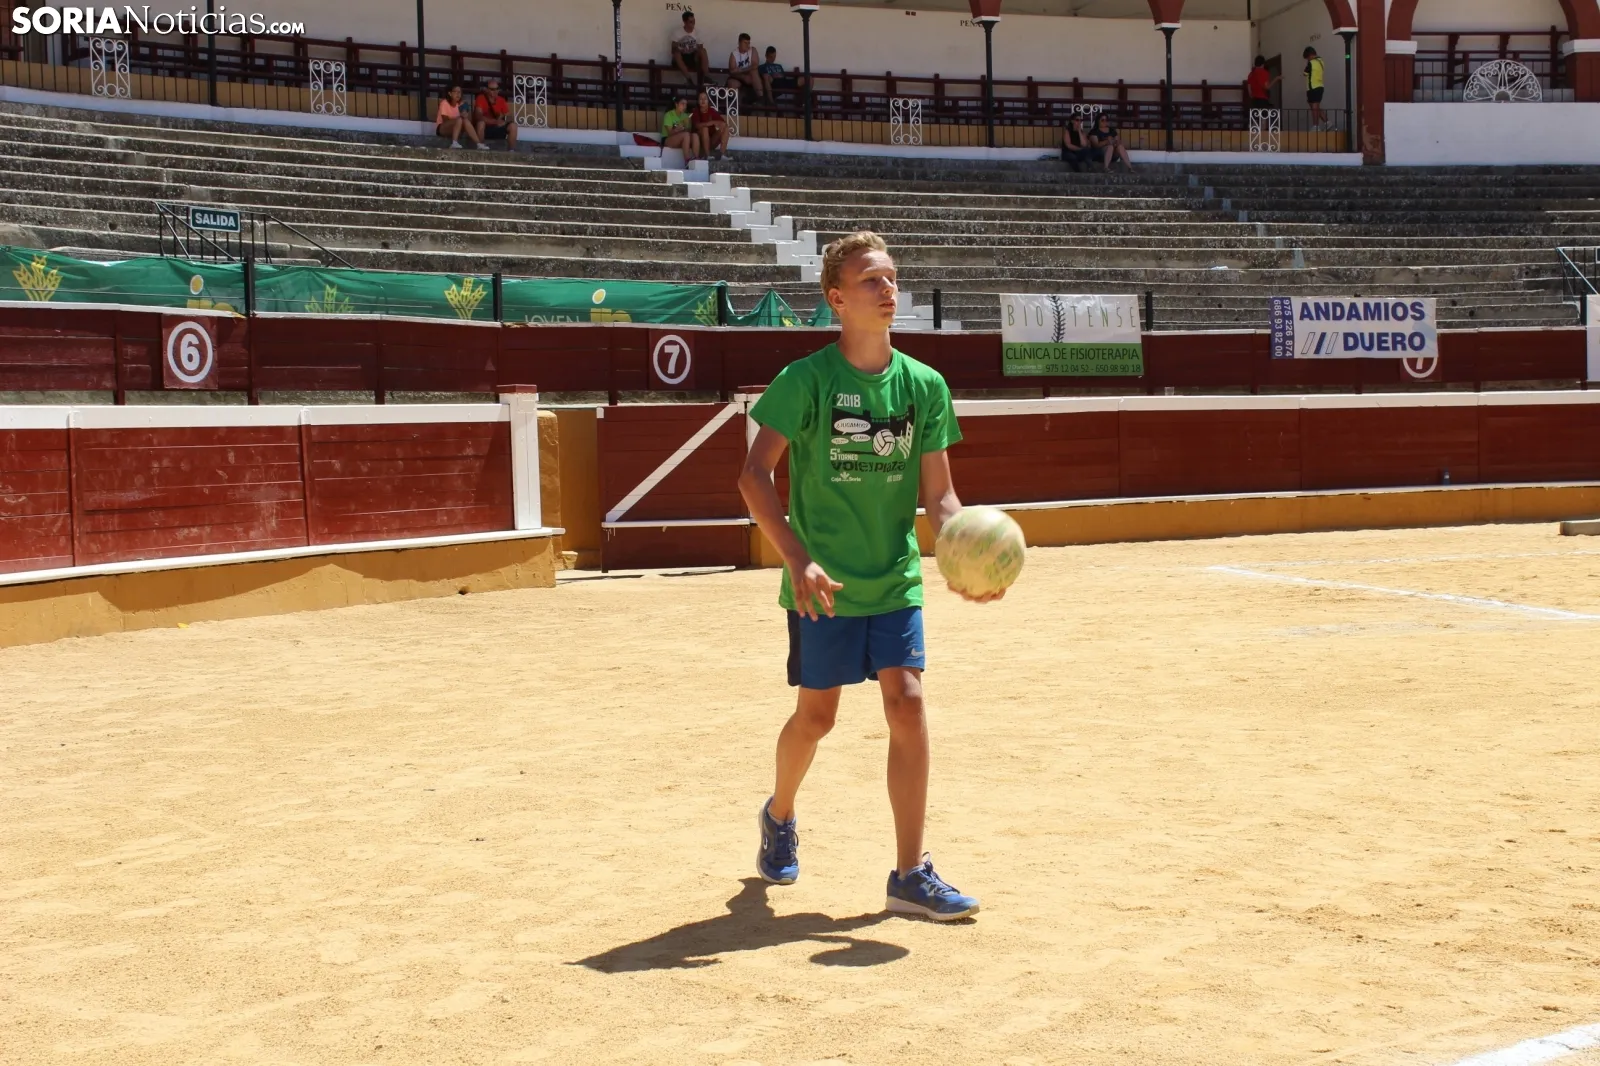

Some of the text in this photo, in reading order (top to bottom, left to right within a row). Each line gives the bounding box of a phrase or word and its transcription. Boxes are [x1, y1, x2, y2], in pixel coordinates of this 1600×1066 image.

[666, 2, 693, 12] PEÑAS
[195, 212, 236, 227] SALIDA
[1070, 305, 1137, 328] TENSE
[1299, 301, 1426, 321] ANDAMIOS
[1273, 299, 1283, 357] 686 93 82 00
[1283, 299, 1294, 357] 975 226 874
[1343, 331, 1426, 351] DUERO
[180, 333, 201, 371] 6
[664, 344, 680, 374] 7
[1005, 345, 1140, 361] CLÍNICA DE FISIOTERAPIA
[1045, 364, 1059, 373] 975
[1061, 364, 1069, 373] 12
[1081, 364, 1089, 373] 52
[1095, 364, 1109, 373] 650
[1110, 364, 1119, 373] 98
[1120, 364, 1130, 373] 90
[1132, 364, 1141, 373] 18
[836, 393, 861, 408] 2018
